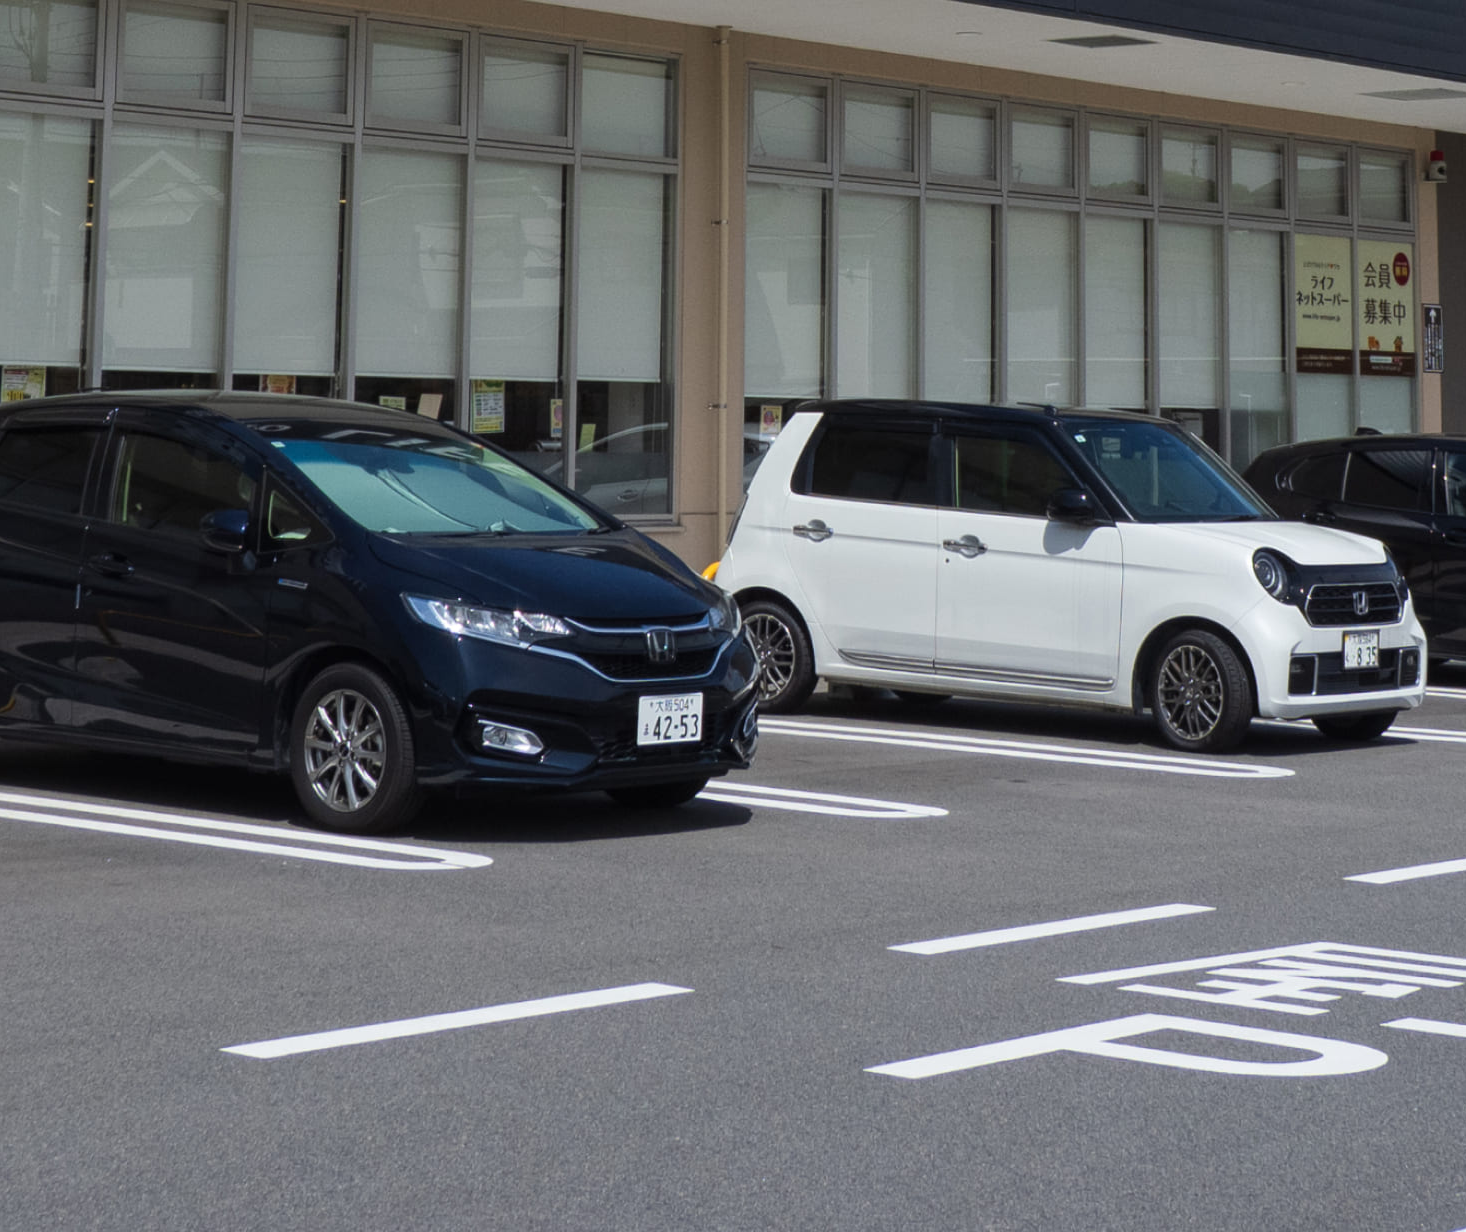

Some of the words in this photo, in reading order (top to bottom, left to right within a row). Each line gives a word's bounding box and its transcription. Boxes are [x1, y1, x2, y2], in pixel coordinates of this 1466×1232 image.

[1310, 275, 1334, 290] ライフ
[1363, 261, 1391, 289] 会員
[1296, 291, 1350, 306] ネットスーパー
[1363, 298, 1407, 326] 募集中
[653, 713, 700, 740] 42-53
